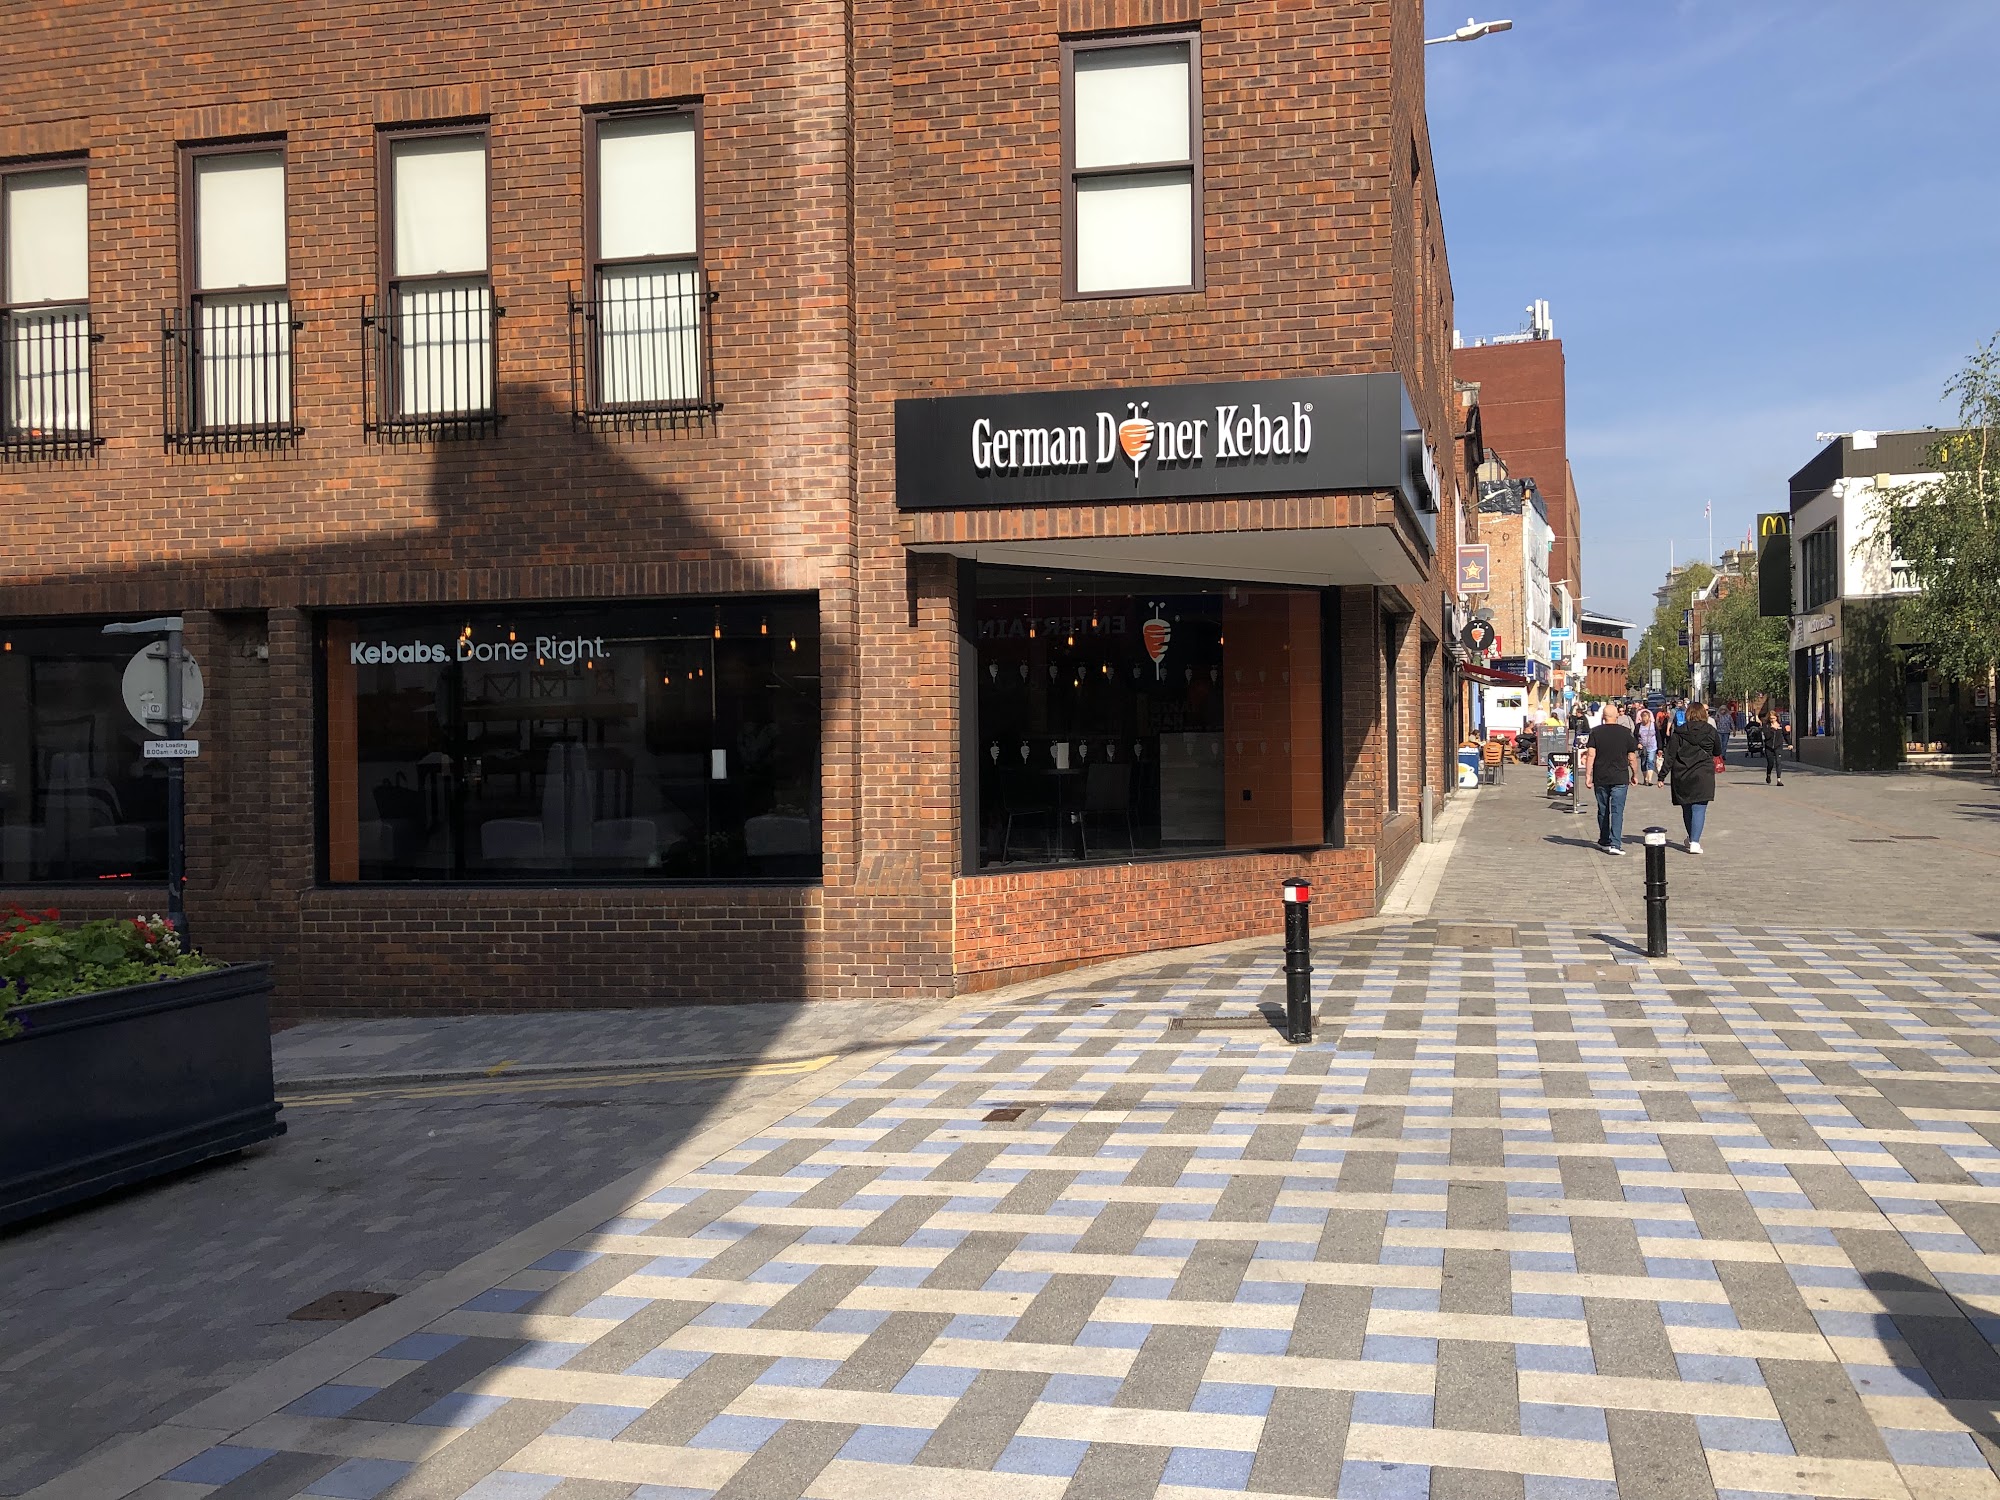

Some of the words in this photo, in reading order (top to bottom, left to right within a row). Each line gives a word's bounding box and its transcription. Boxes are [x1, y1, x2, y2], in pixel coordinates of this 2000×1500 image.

[972, 418, 1089, 469] German
[350, 640, 452, 665] Kebabs.
[456, 639, 529, 662] Done
[535, 635, 611, 665] Right.
